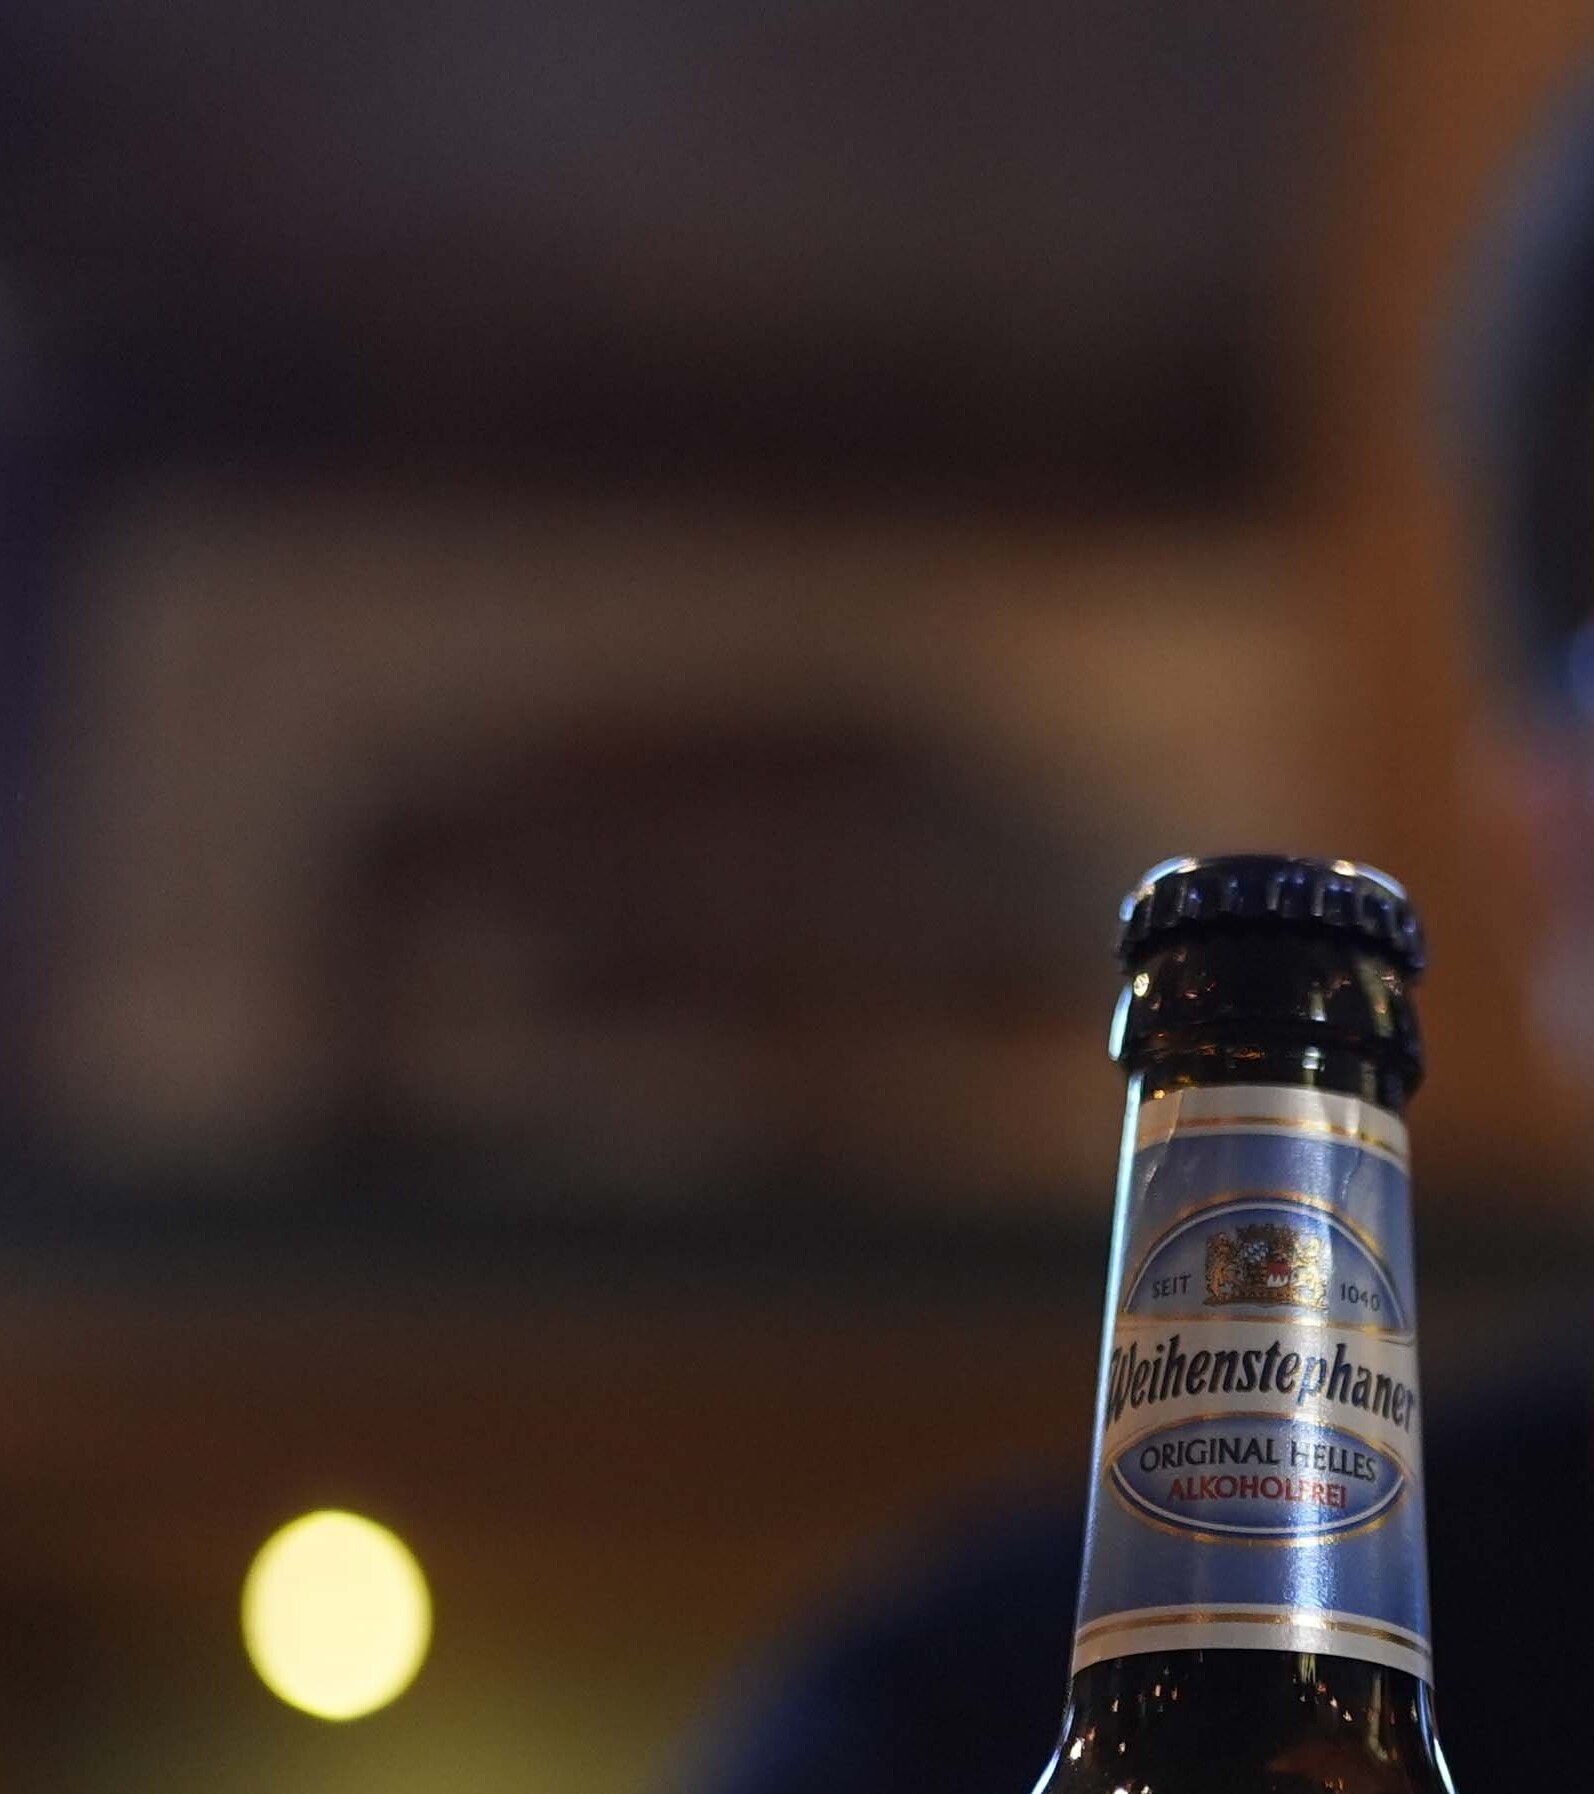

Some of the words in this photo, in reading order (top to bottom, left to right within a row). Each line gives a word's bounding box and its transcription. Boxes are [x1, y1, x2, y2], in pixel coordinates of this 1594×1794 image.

[1152, 1273, 1191, 1298] SEIT
[1340, 1281, 1381, 1311] 1040
[1106, 1334, 1417, 1433] Weihenstephaner
[1140, 1437, 1279, 1473] ORIGINAL
[1289, 1441, 1377, 1481] HELLES
[1167, 1477, 1347, 1509] ALKOHOLFREI
